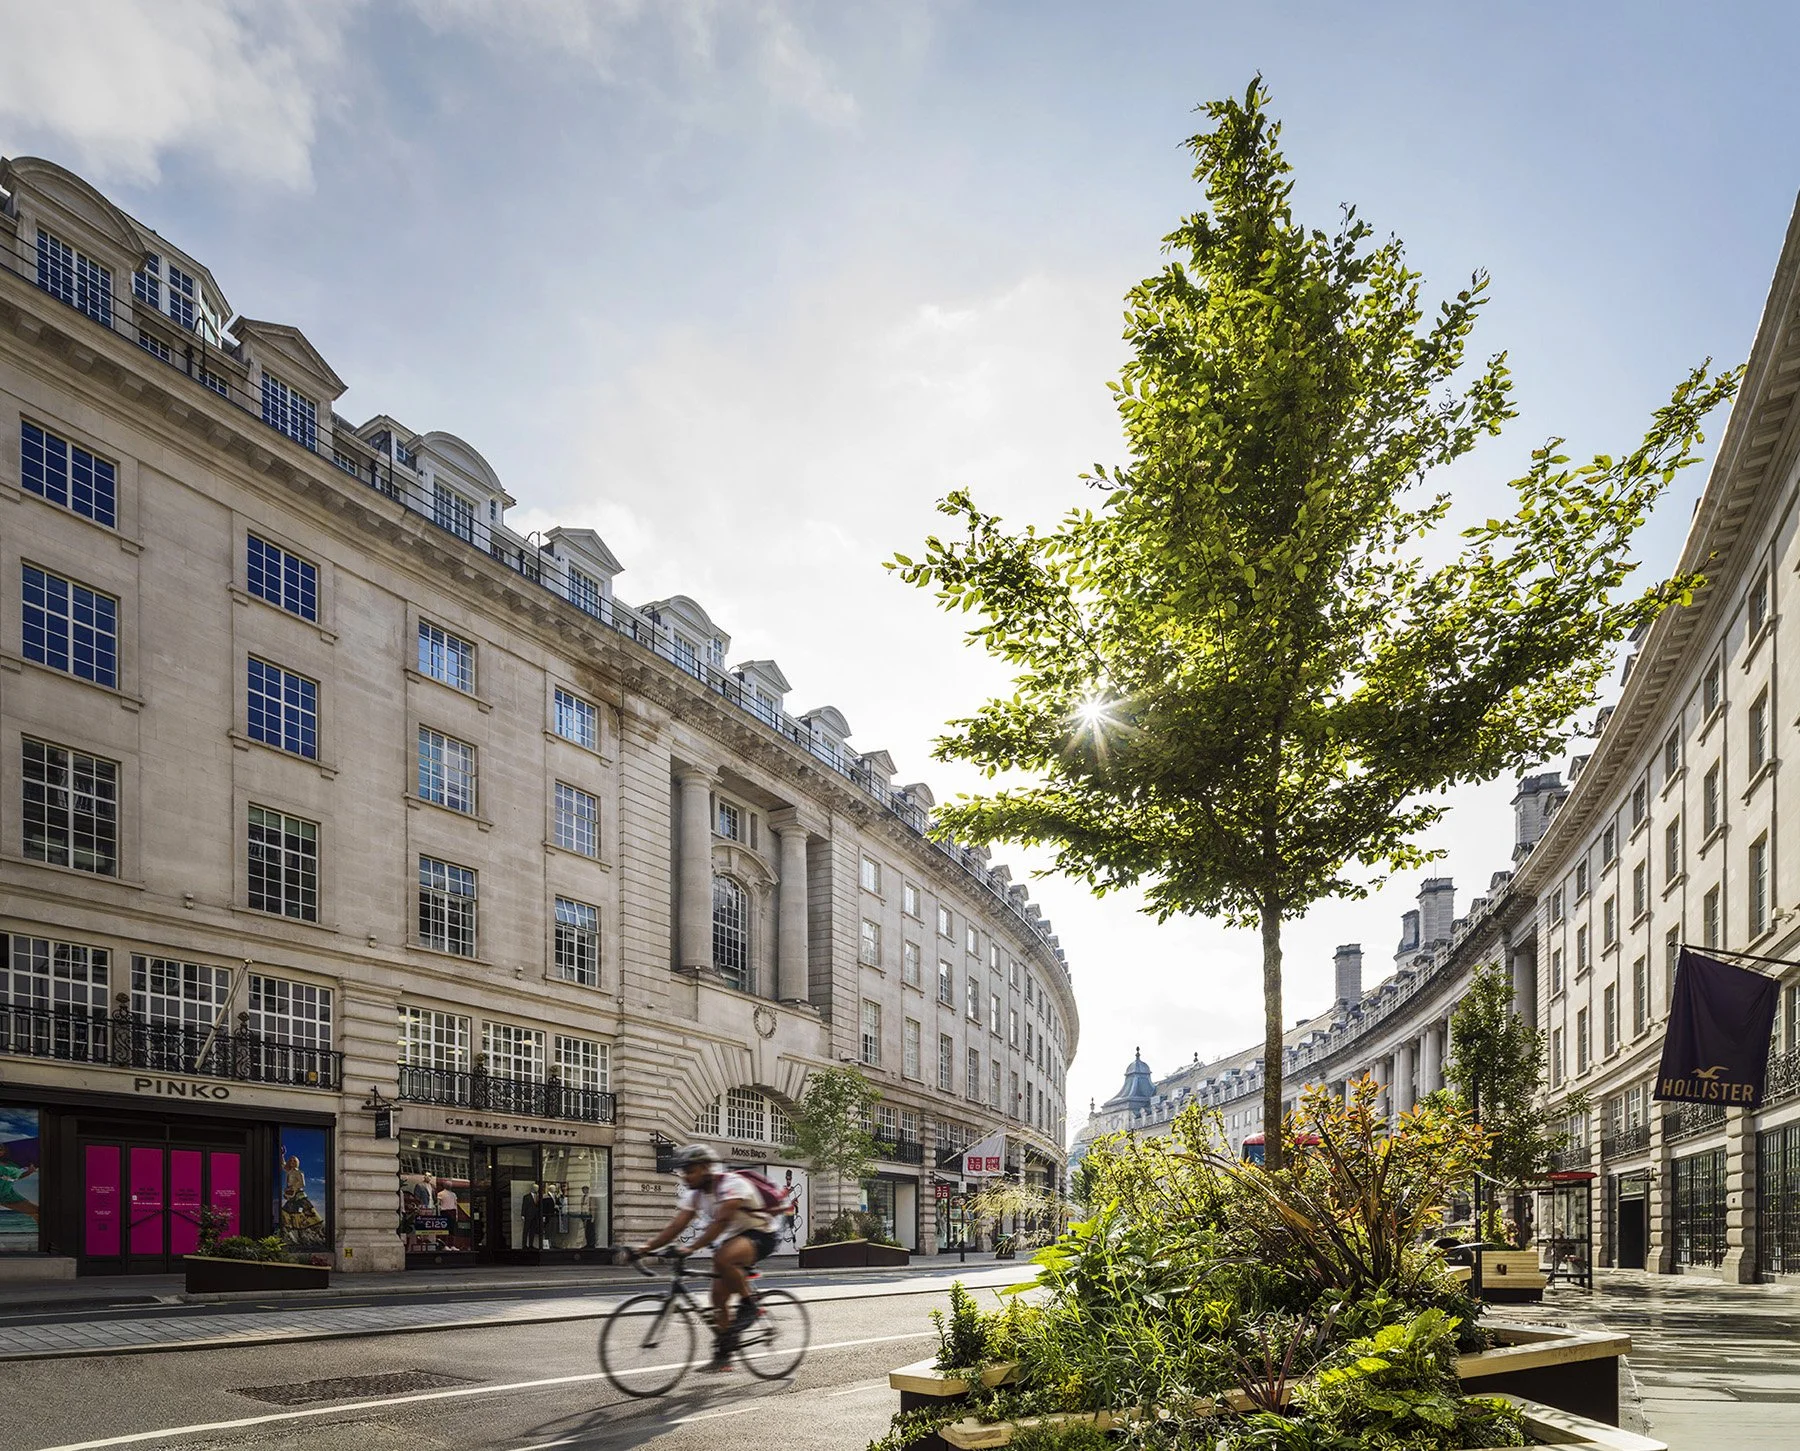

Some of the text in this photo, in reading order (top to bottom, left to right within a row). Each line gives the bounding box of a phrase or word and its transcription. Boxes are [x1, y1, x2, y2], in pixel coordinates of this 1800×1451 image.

[134, 1077, 230, 1100] PINKO
[1662, 1079, 1754, 1102] HOLLISTER
[445, 1118, 577, 1137] CHARLES TYRWHITT
